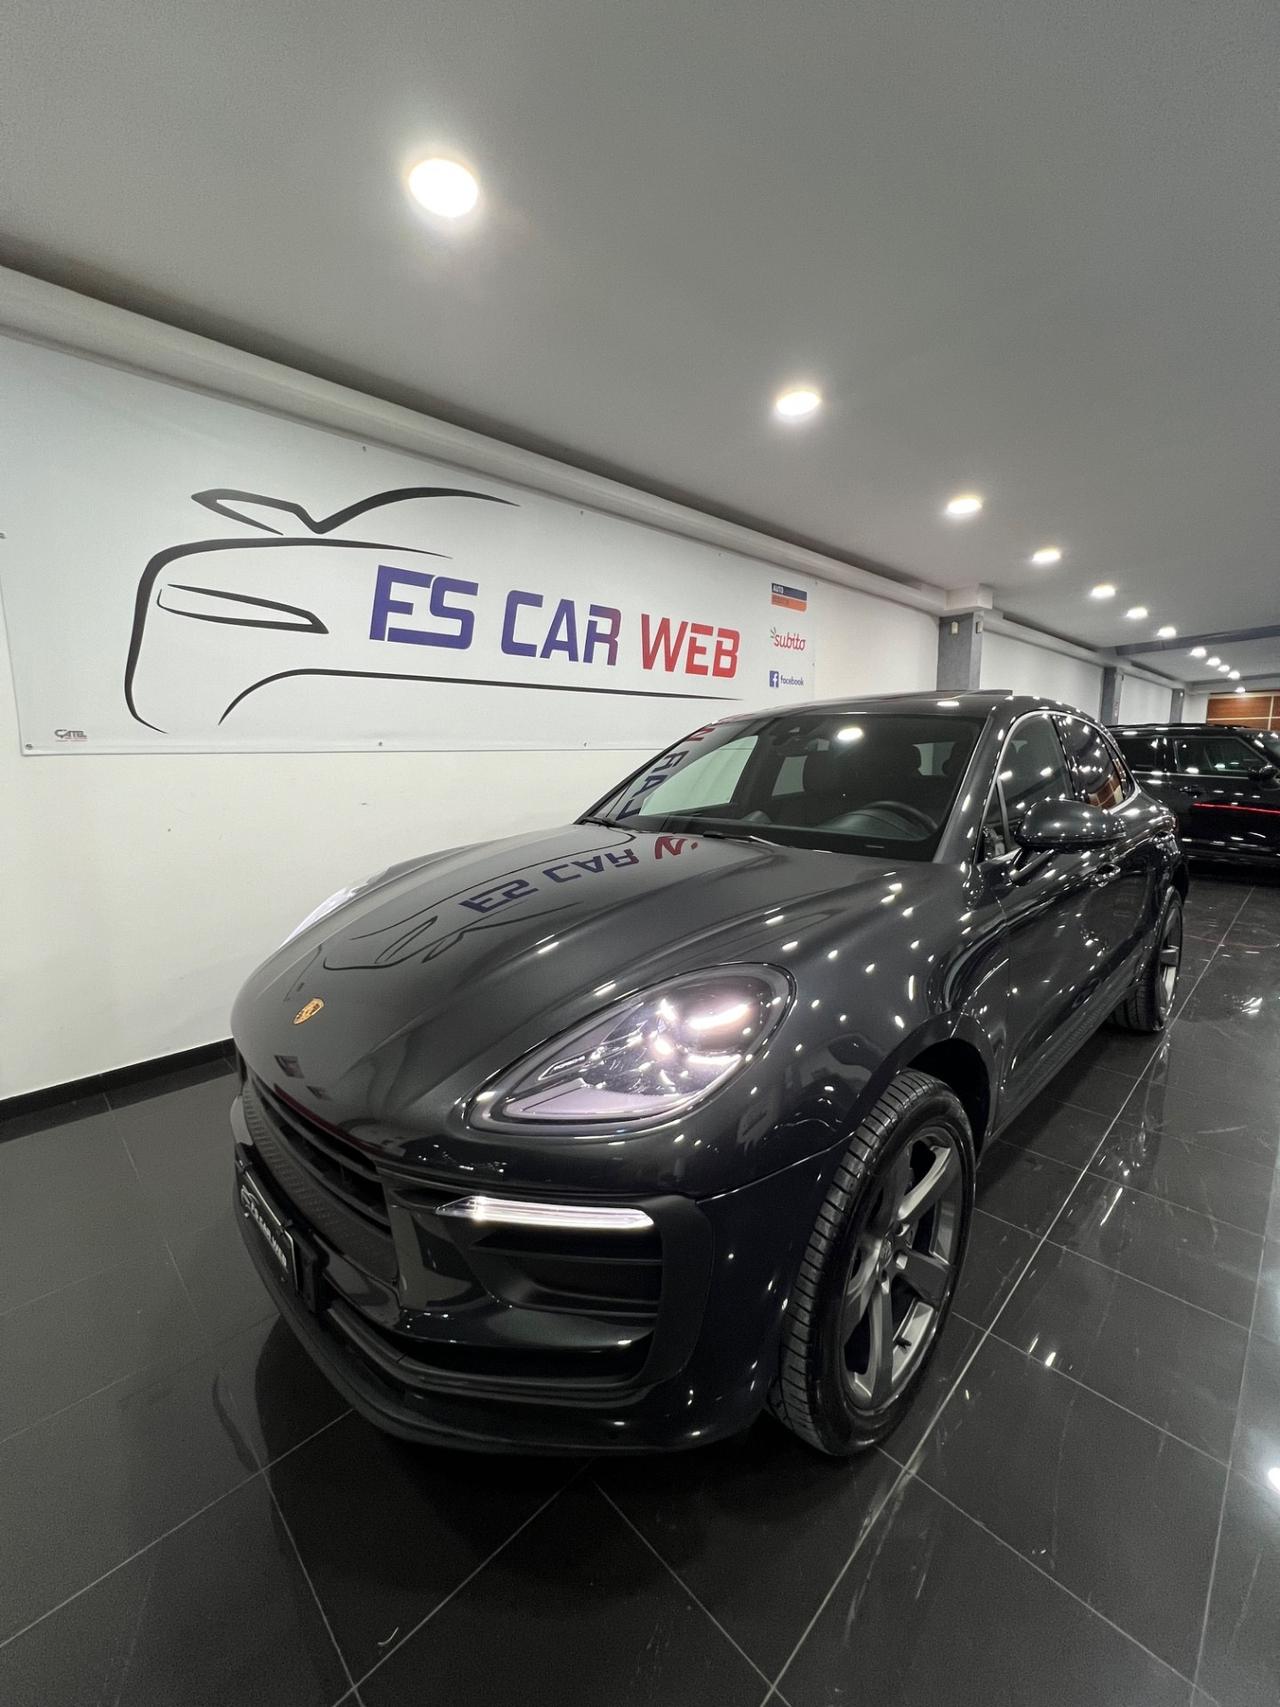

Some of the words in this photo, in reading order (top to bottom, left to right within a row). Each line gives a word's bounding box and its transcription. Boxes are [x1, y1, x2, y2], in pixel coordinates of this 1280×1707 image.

[369, 564, 479, 650] ES
[501, 590, 622, 667] CAR
[641, 613, 741, 679] WEB
[774, 632, 806, 651] subito
[780, 675, 804, 686] facebook
